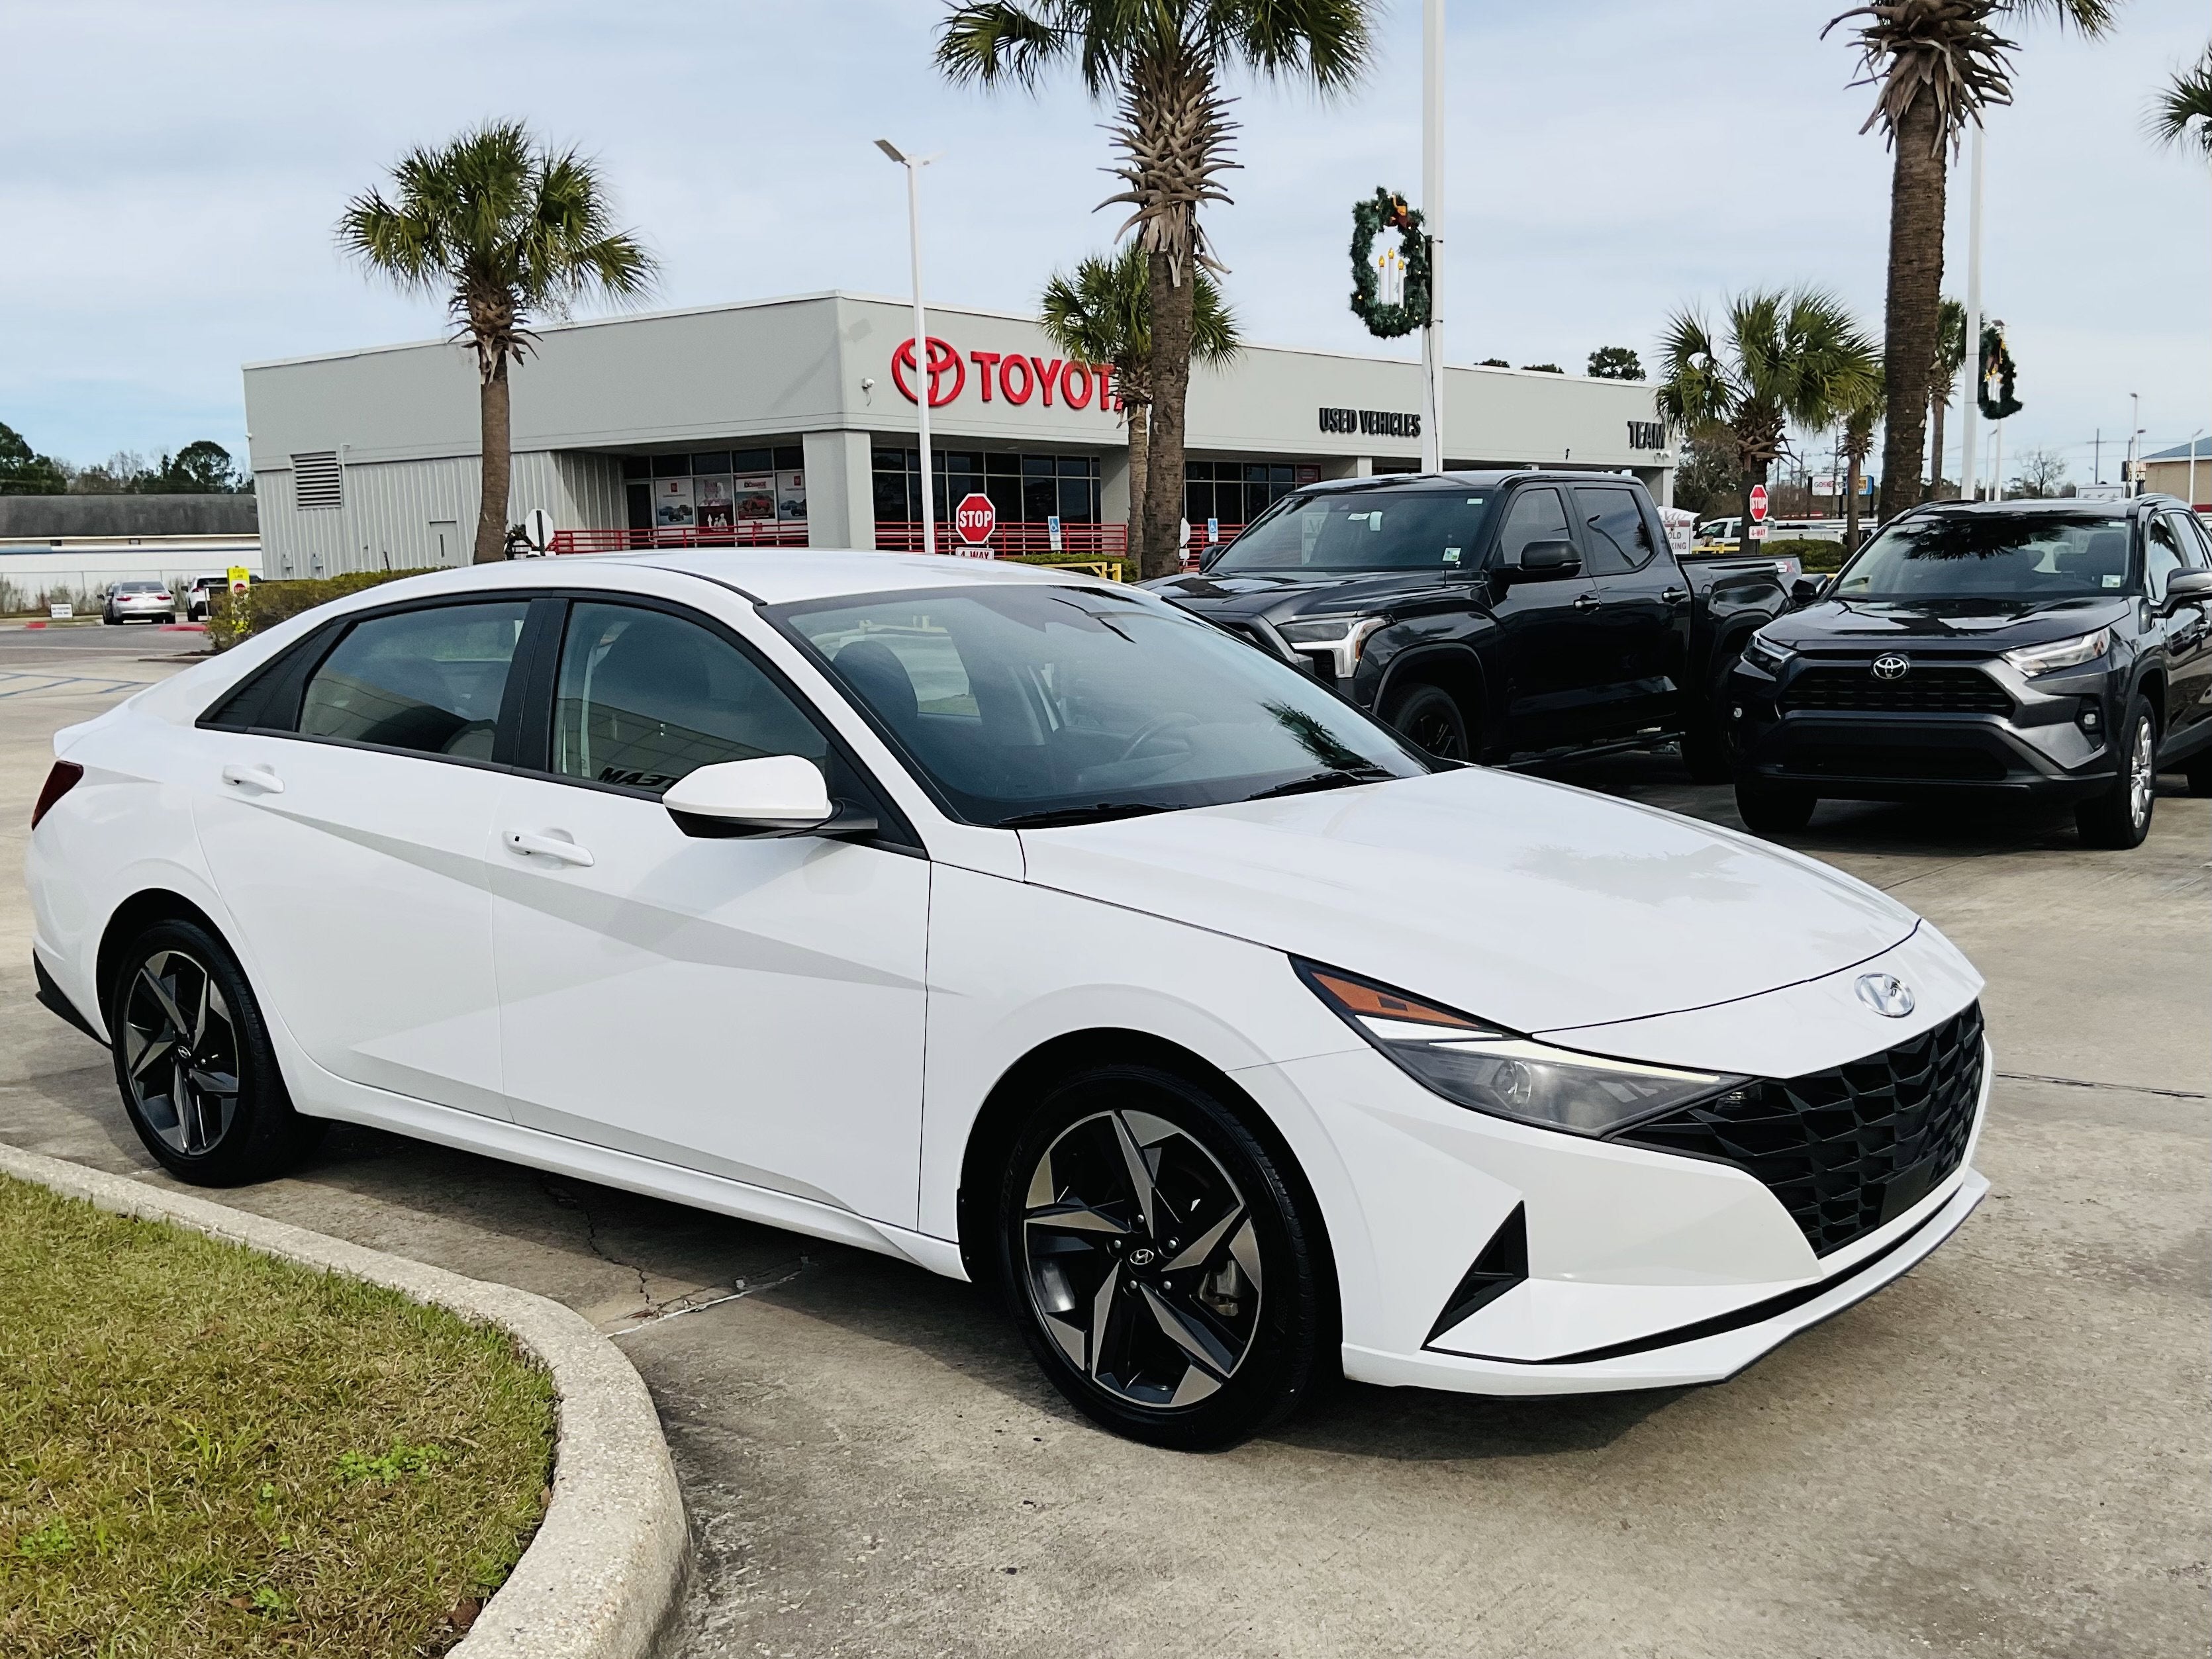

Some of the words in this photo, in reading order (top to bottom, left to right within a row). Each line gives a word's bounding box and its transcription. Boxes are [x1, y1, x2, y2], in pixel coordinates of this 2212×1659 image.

[970, 351, 1124, 412] TOYOT
[1319, 407, 1357, 433] USED
[1359, 410, 1421, 436] VEHICLES
[1627, 420, 1666, 450] TEAM
[1751, 497, 1766, 510] STOP
[959, 510, 992, 528] STOP
